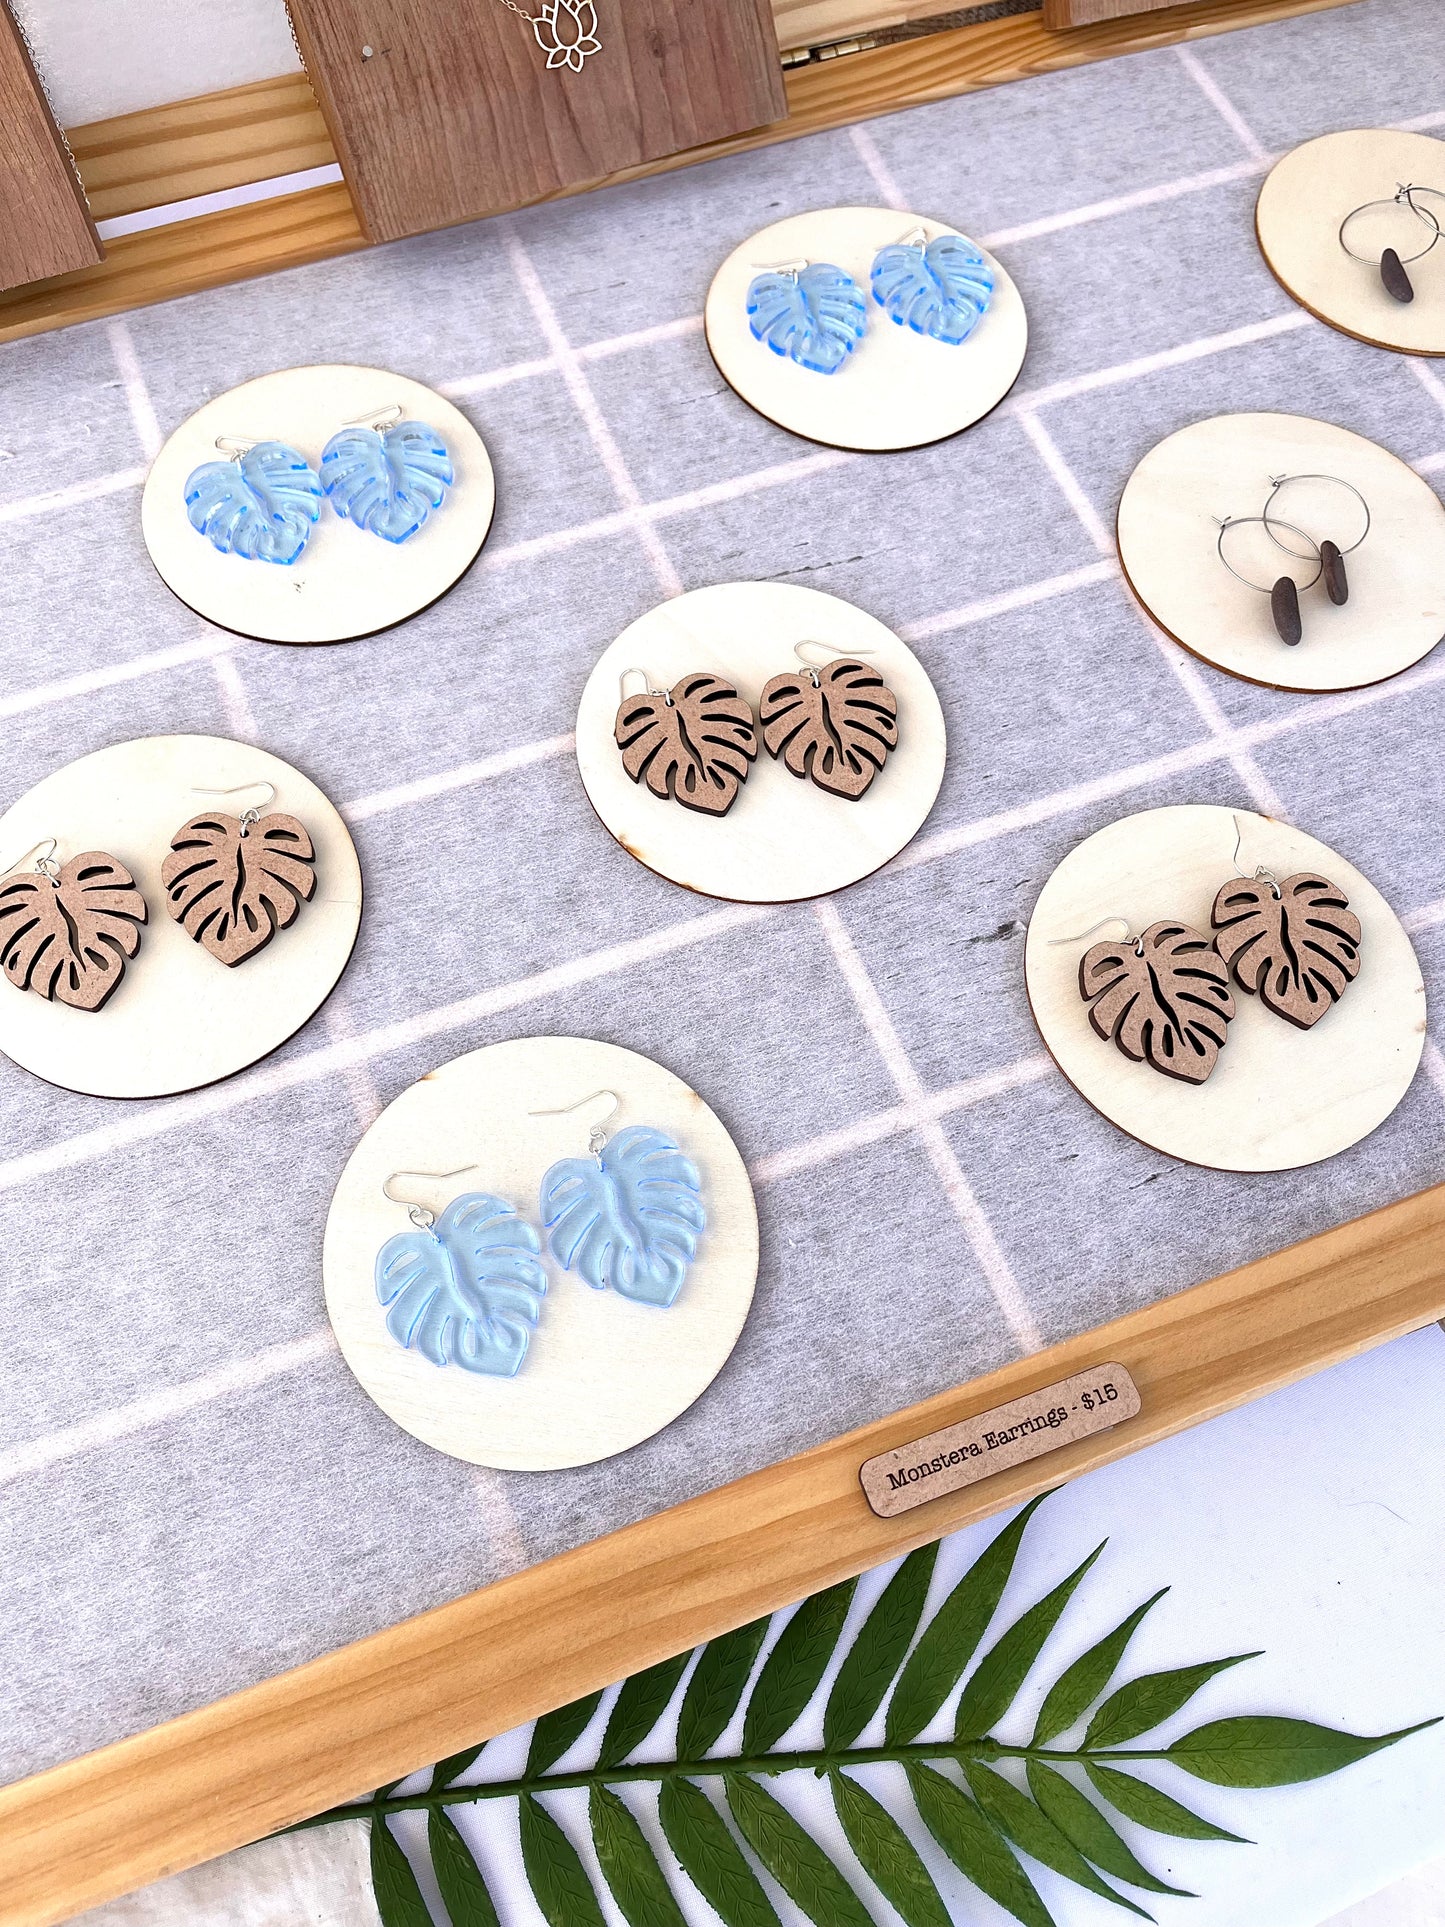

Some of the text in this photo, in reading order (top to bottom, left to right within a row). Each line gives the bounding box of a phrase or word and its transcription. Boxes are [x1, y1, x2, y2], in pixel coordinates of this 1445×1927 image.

[886, 1441, 982, 1490] Monstera
[982, 1404, 1069, 1451] Earrings
[1080, 1383, 1119, 1412] $15
